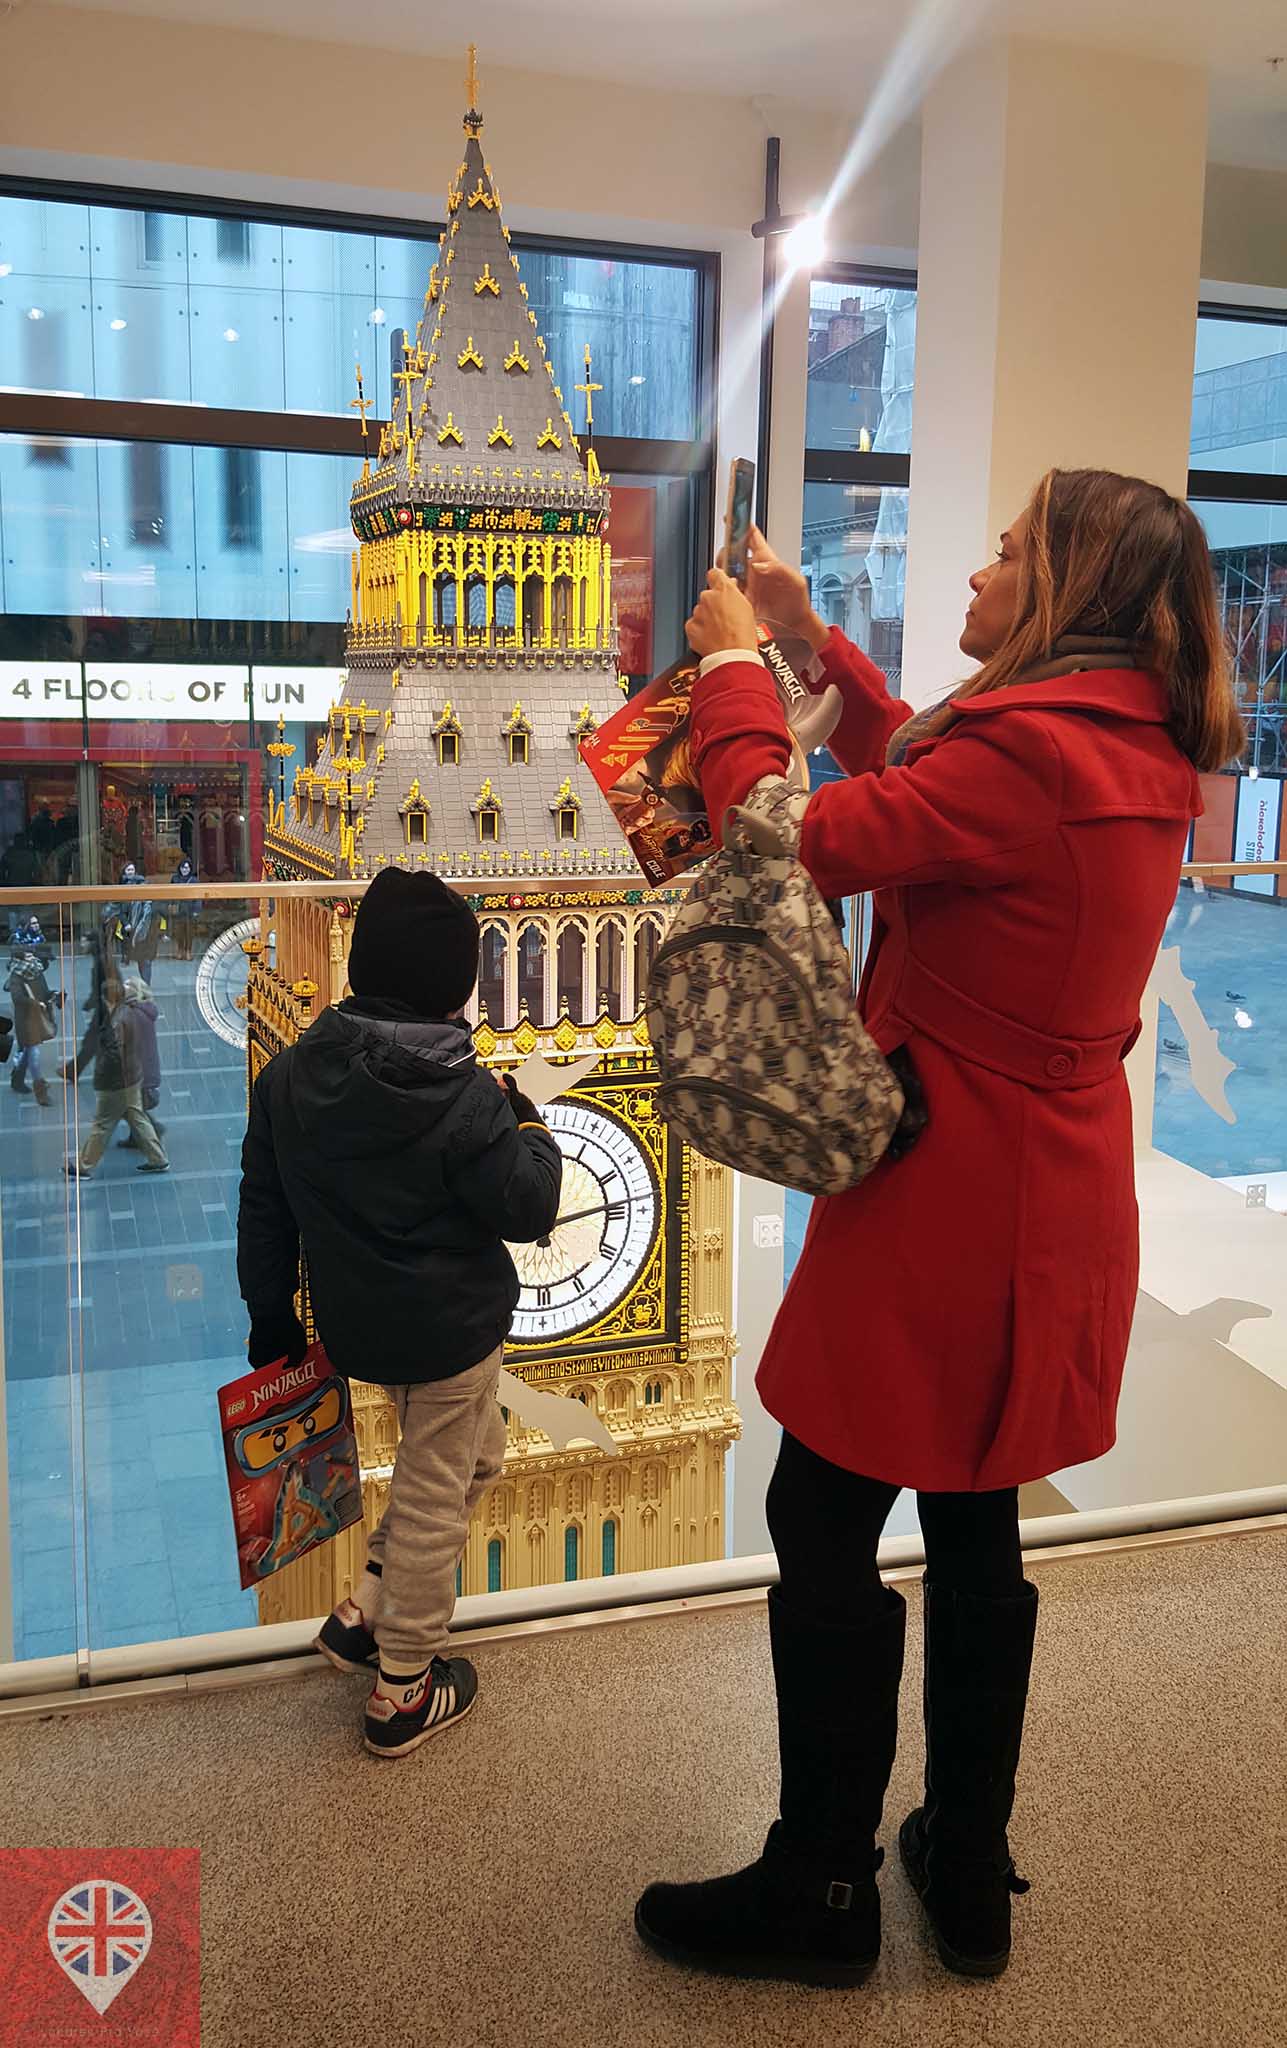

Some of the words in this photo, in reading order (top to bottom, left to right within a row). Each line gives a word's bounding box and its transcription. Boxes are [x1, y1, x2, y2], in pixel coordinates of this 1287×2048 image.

[12, 679, 31, 699] 4
[44, 679, 178, 704] FLOO
[188, 681, 226, 703] OF
[759, 642, 805, 704] NINJAGO
[646, 860, 666, 879] COLE
[227, 1399, 247, 1416] LEGO
[250, 1360, 321, 1412] NINJAGO
